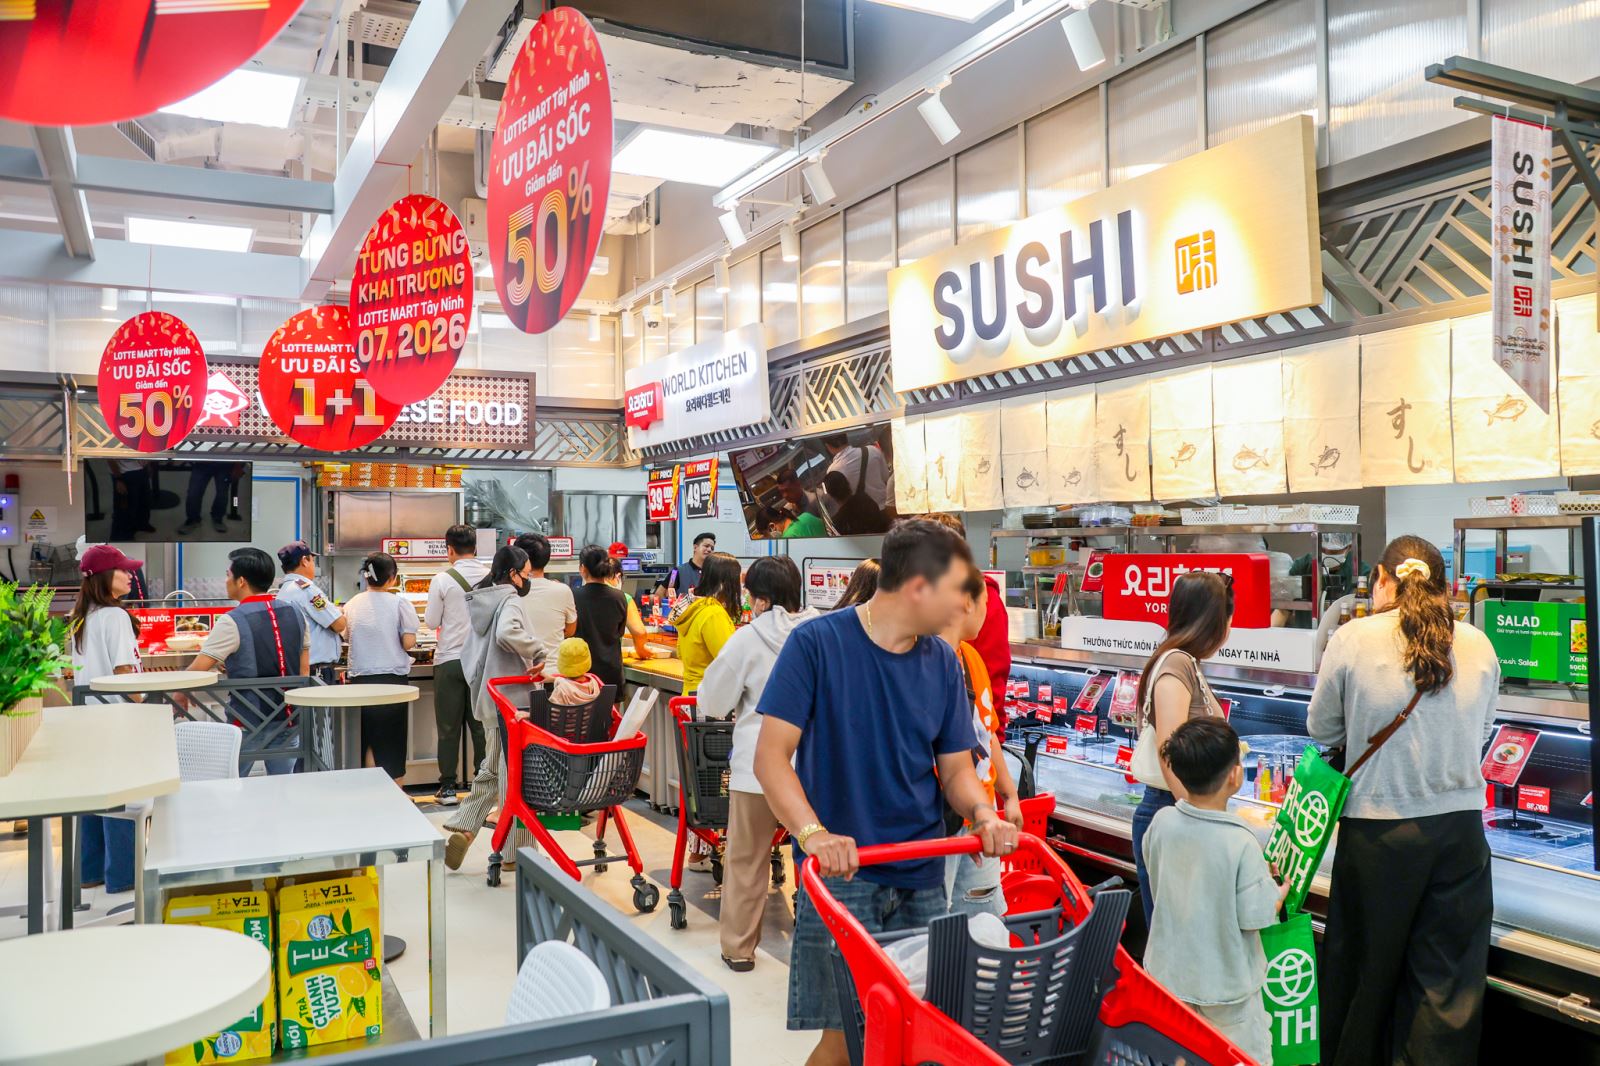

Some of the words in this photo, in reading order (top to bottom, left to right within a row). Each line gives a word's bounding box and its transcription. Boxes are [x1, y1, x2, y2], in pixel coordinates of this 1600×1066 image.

[504, 114, 527, 145] LOTTE
[528, 96, 552, 128] MART
[552, 86, 568, 110] Tây
[570, 69, 590, 98] Ninh
[502, 147, 524, 186] ƯU
[526, 124, 553, 172] ĐÃI
[556, 100, 590, 152] SỐC
[525, 174, 546, 197] Giảm
[546, 160, 562, 184] đến
[506, 160, 593, 306] 50%
[1512, 151, 1534, 280] SUSHI
[412, 229, 466, 265] BỪNG
[358, 278, 394, 304] KHAI
[397, 262, 465, 296] TRƯƠNG
[932, 209, 1136, 351] SUSHI
[358, 309, 388, 327] LOTTE
[390, 302, 420, 322] MART
[421, 300, 440, 317] Tây
[440, 294, 464, 312] Ninh
[114, 350, 136, 361] LOTTE
[137, 348, 158, 359] MART
[159, 348, 173, 357] Tây
[174, 346, 190, 356] Ninh
[281, 358, 308, 374] ƯU
[312, 356, 345, 374] ĐÃI
[350, 358, 361, 374] S
[282, 344, 314, 353] LOTTE
[314, 344, 342, 353] MART
[113, 364, 133, 380] ƯU
[136, 360, 160, 378] ĐÃI
[162, 357, 191, 376] SỐC
[136, 380, 154, 390] Giảm
[154, 378, 168, 389] đến
[661, 368, 696, 398] WORLD
[698, 351, 748, 388] KITCHEN
[119, 385, 192, 438] 50%
[294, 378, 384, 426] 1+1
[396, 400, 444, 423] ESE
[449, 400, 522, 426] FOOD
[1112, 423, 1138, 482] すし
[1386, 397, 1425, 474] すし
[696, 462, 710, 472] PRICE
[1144, 602, 1168, 614] YOR
[1496, 614, 1540, 628] SALAD
[1113, 638, 1132, 650] THỨC
[1134, 640, 1152, 650] MÓN
[1218, 648, 1242, 659] NGAY
[1244, 650, 1258, 662] TẠI
[1261, 649, 1280, 662] NHÀ
[1518, 658, 1538, 667] Salad
[1264, 822, 1313, 893] EARTH
[296, 996, 309, 1018] TRÀ
[306, 976, 328, 1028] CHANH
[1274, 1004, 1317, 1046] TH
